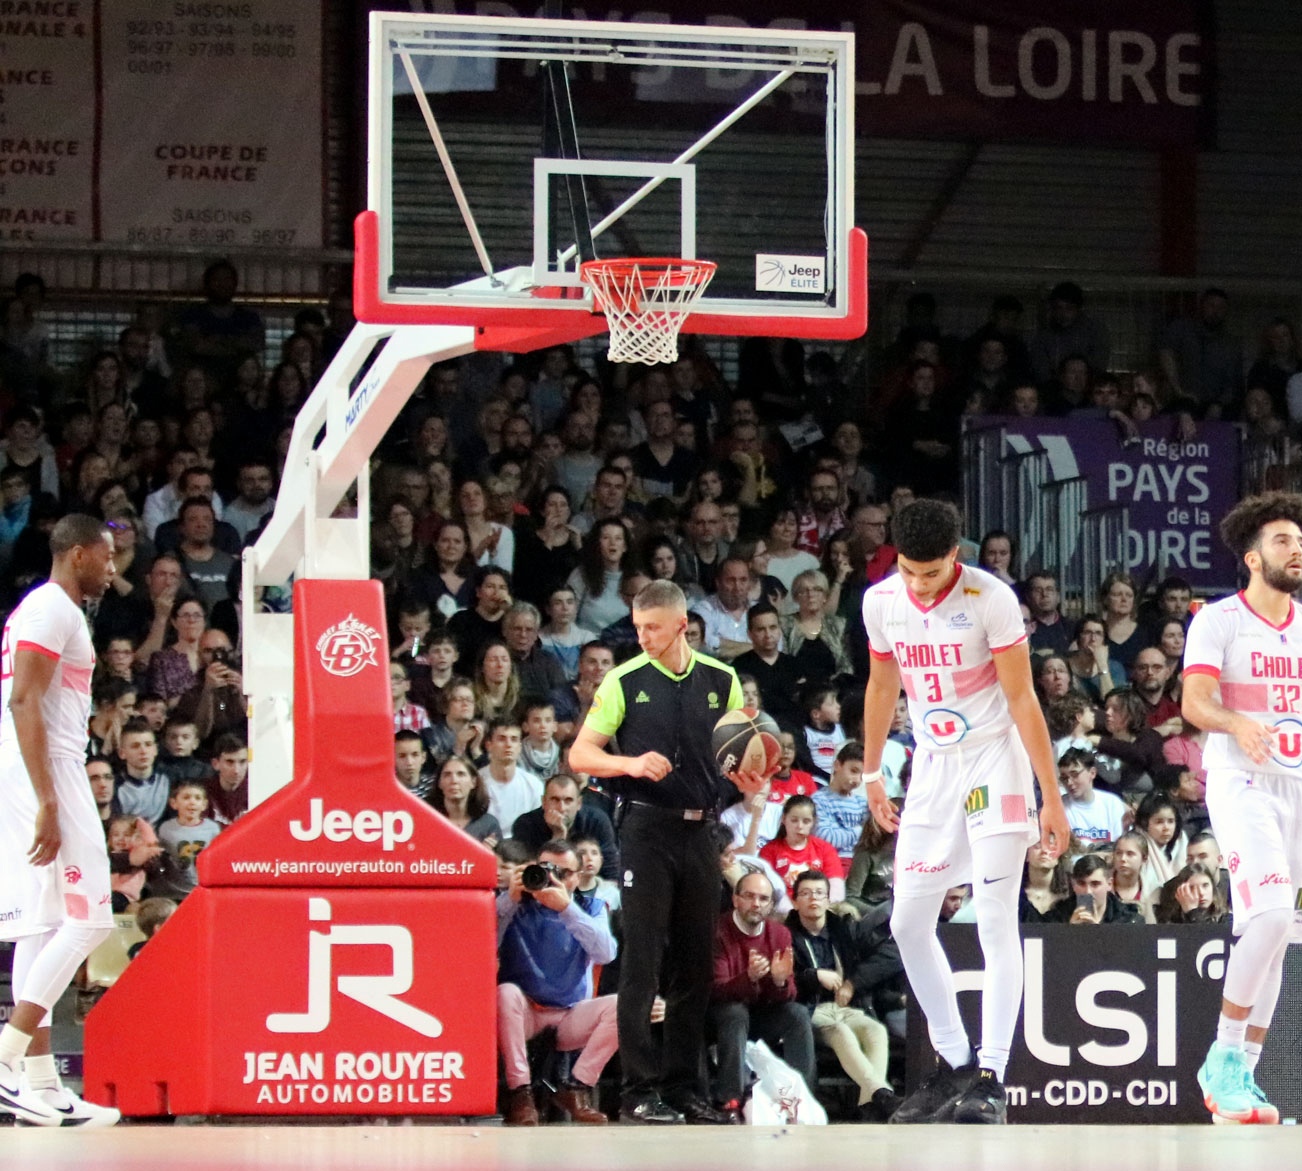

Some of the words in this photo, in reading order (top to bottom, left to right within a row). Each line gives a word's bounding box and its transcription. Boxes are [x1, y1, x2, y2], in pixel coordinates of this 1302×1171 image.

[174, 3, 252, 18] SAISONS
[0, 21, 66, 38] NALE
[973, 24, 1200, 107] LOIRE
[0, 70, 54, 86] NCE
[154, 144, 232, 161] COUPE
[239, 146, 268, 162] DE
[166, 164, 257, 182] FRANCE
[172, 207, 252, 224] SAISONS
[788, 264, 821, 279] Jeep
[1143, 438, 1210, 461] Région
[1107, 462, 1211, 503] PAYS
[1166, 506, 1190, 525] de
[1194, 506, 1211, 525] la
[895, 641, 964, 668] CHOLET
[924, 673, 943, 703] 3
[1272, 684, 1301, 714] 32
[930, 720, 957, 738] U
[1278, 733, 1302, 758] U
[289, 798, 415, 851] Jeep
[242, 1051, 325, 1085] JEAN
[335, 1051, 466, 1081] ROUYER
[256, 1084, 454, 1105] AUTOMOBILES
[1044, 1079, 1109, 1107] CDD
[1126, 1080, 1178, 1107] CDI
